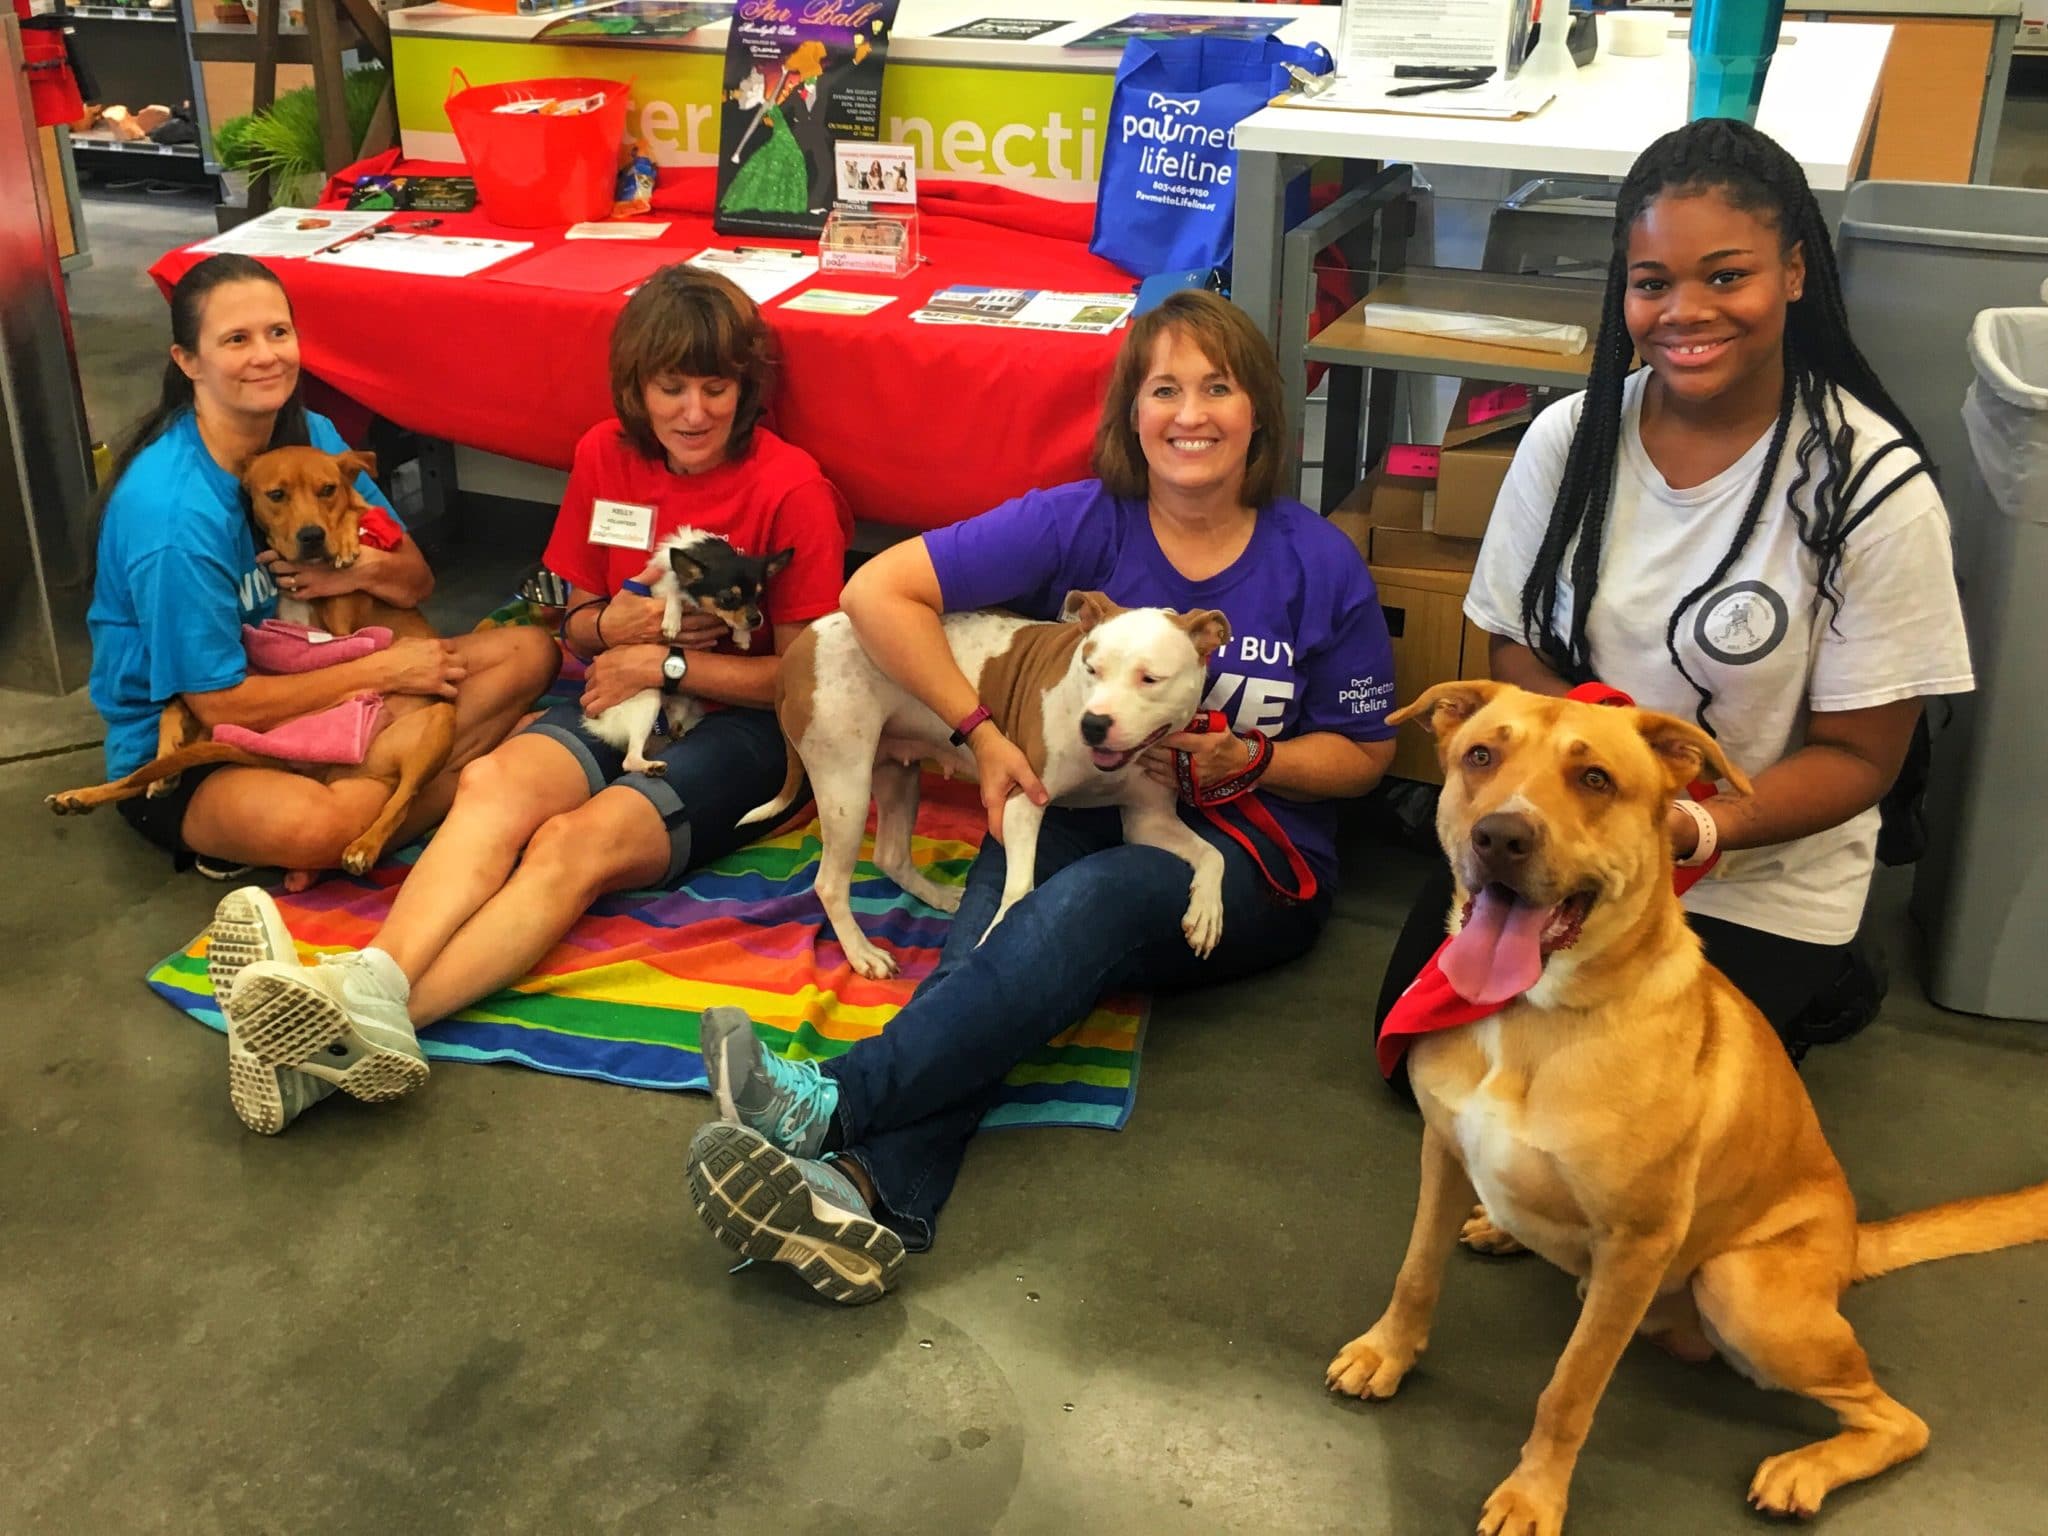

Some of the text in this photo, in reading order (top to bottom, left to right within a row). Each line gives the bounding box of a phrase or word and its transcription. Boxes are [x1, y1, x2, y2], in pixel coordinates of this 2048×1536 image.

[740, 0, 884, 28] Fur Ball
[1139, 146, 1233, 186] lifeline
[1240, 636, 1294, 667] BUY
[1338, 682, 1395, 704] pawmetto
[1351, 698, 1388, 714] lifeline
